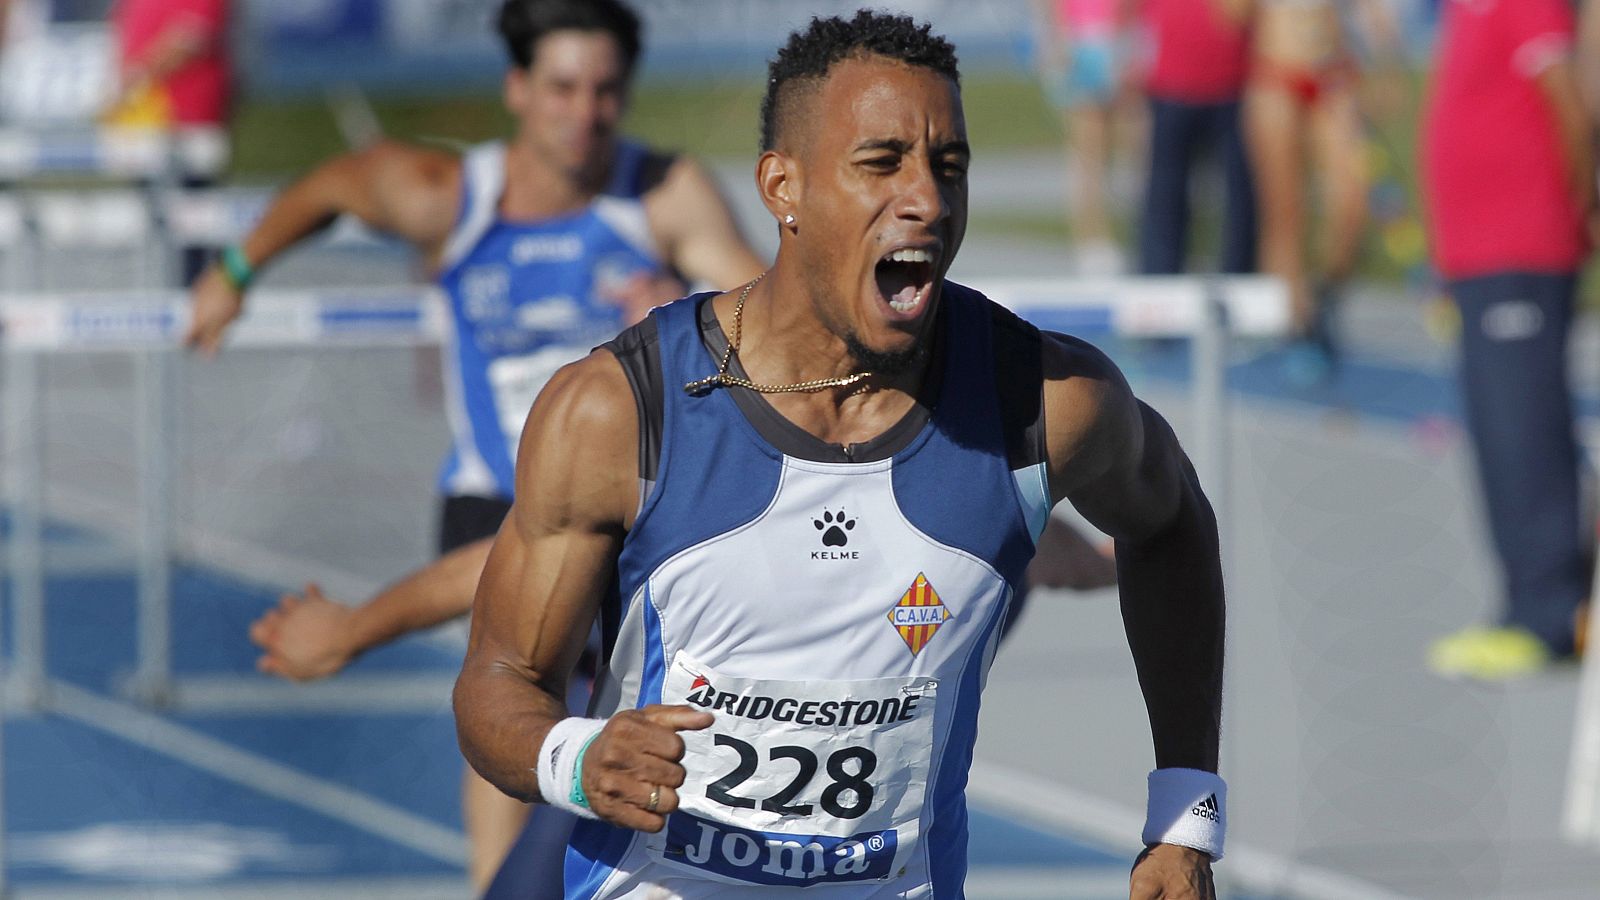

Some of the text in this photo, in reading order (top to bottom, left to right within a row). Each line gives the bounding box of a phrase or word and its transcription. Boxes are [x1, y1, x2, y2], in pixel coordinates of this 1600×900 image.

[811, 551, 860, 560] KELME
[895, 608, 942, 623] C.A.V.A.
[686, 680, 920, 727] BRIDGESTONE
[705, 733, 877, 819] 228
[1192, 806, 1221, 824] adida
